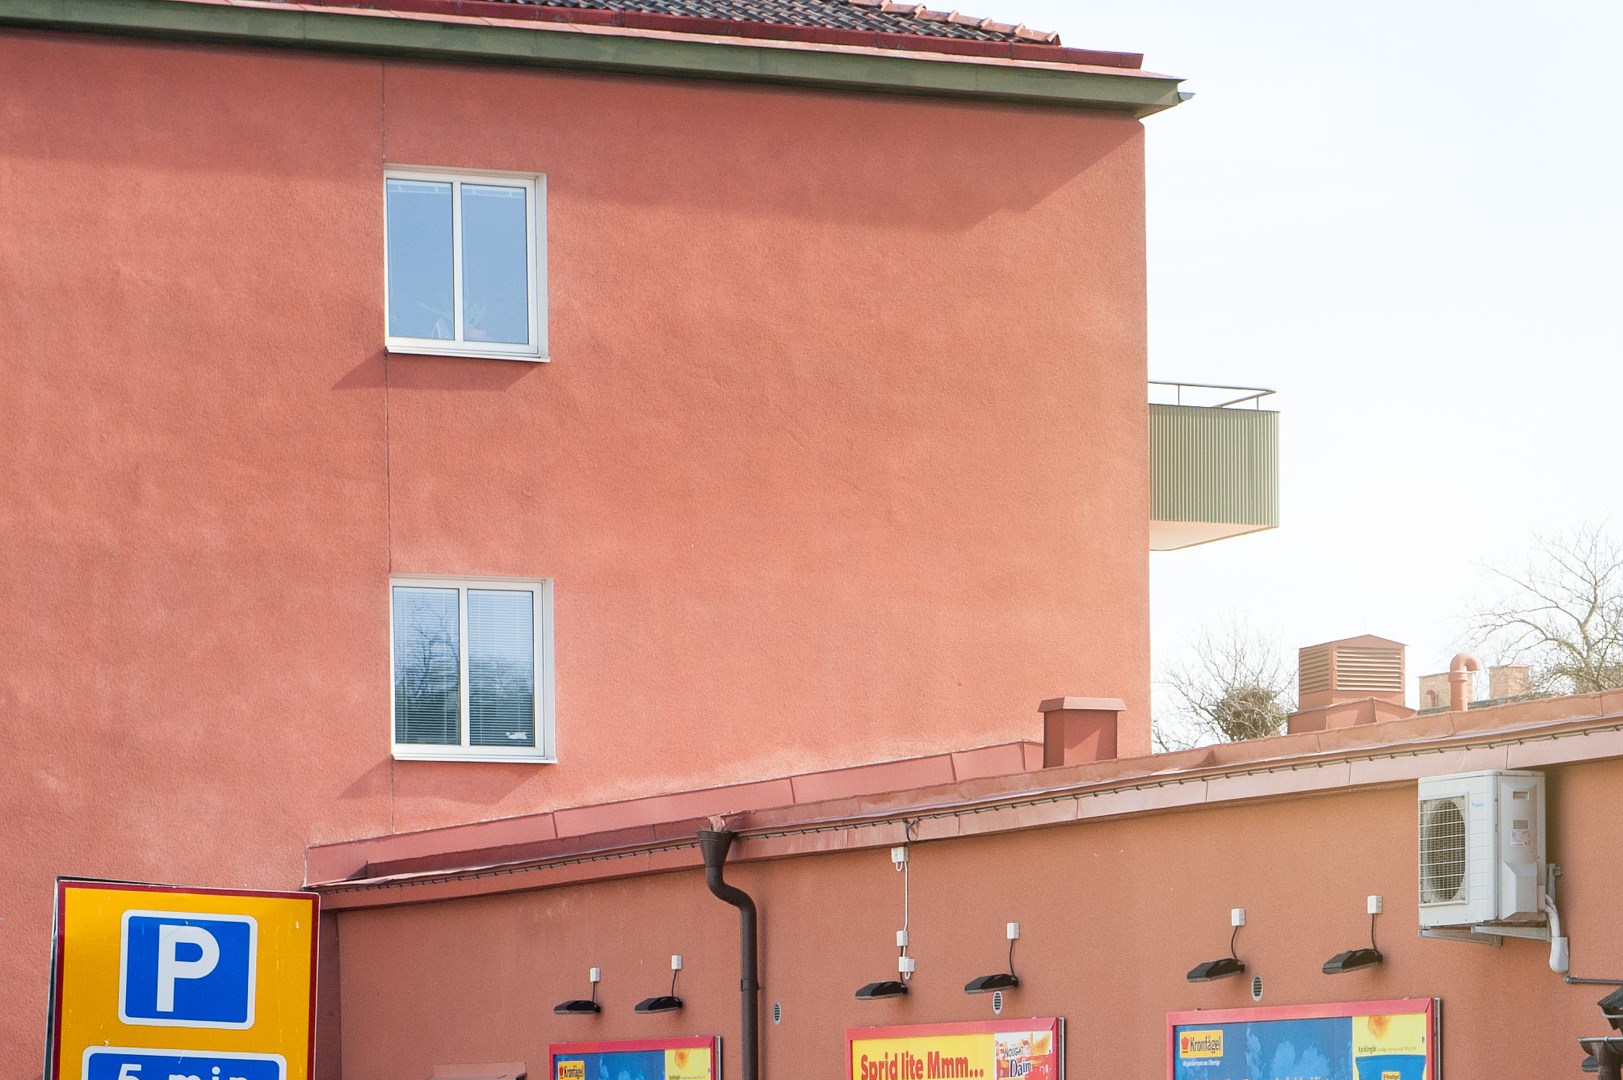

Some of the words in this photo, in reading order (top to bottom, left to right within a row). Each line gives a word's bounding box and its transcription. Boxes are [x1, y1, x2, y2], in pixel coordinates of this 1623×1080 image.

[157, 924, 220, 1012] P
[901, 1051, 923, 1080] lite
[927, 1049, 985, 1080] Mmm...
